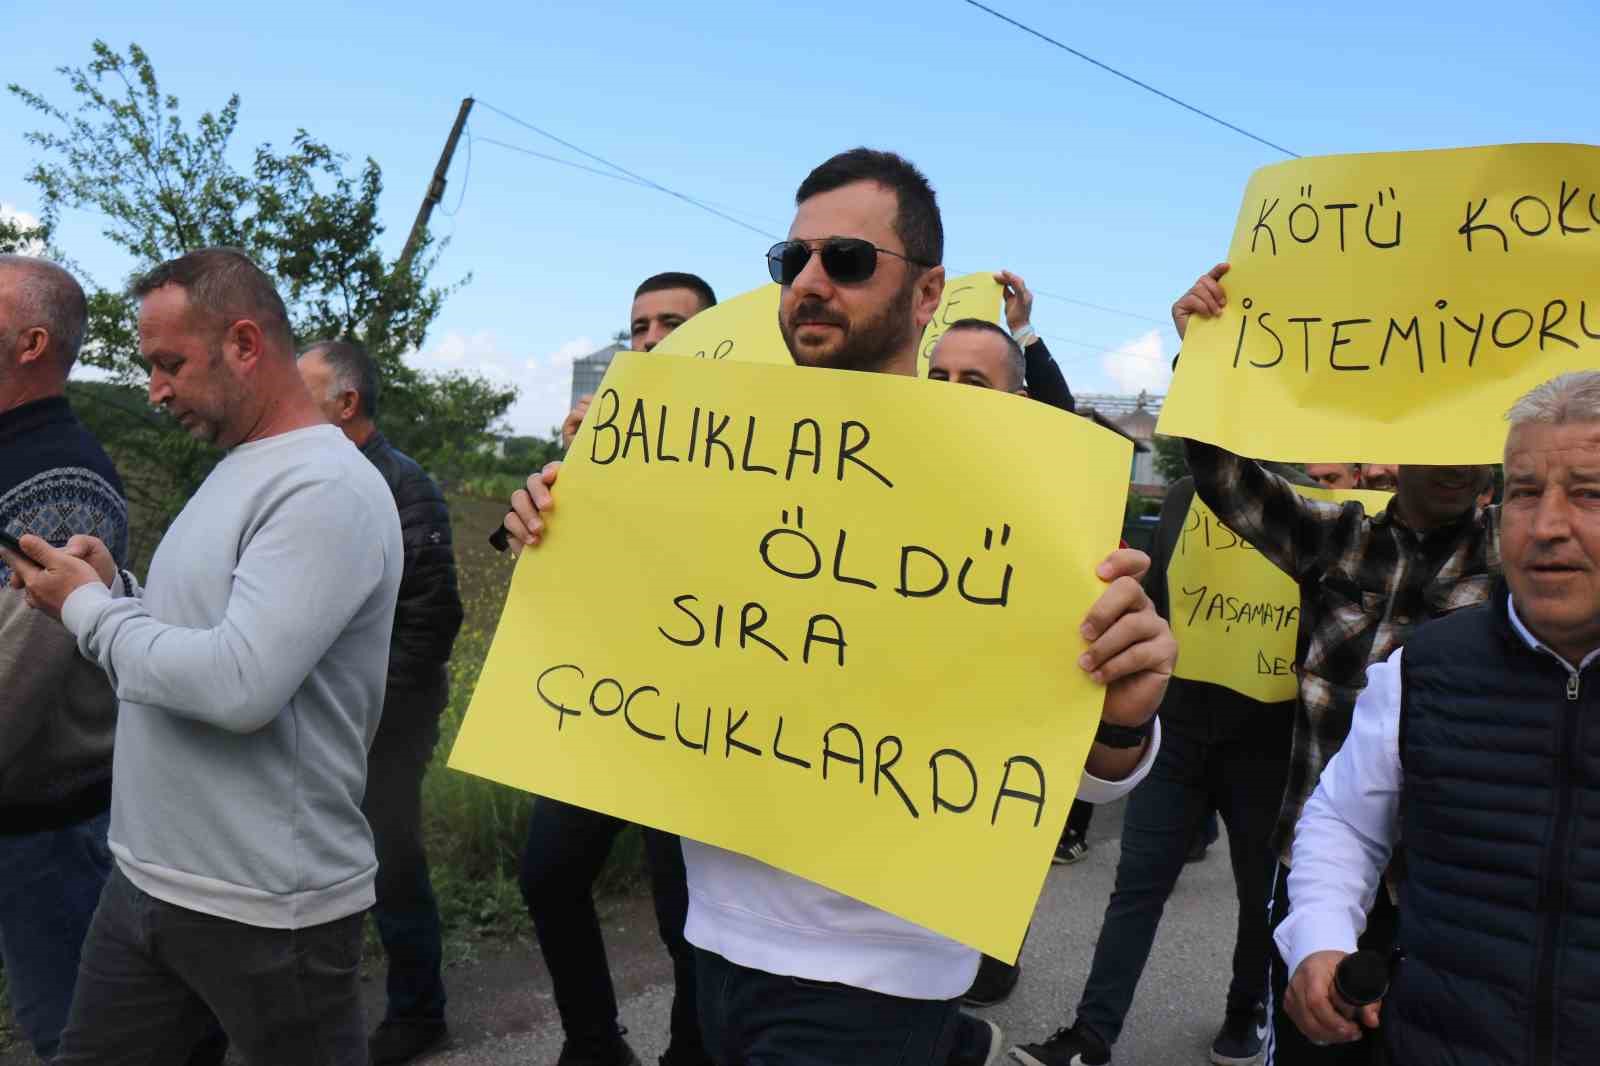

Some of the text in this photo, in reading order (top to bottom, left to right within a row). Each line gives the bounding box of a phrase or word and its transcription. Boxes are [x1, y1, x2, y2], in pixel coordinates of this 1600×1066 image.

[1251, 183, 1402, 256] KÖTÜ
[590, 388, 894, 489] BALIKLAR
[759, 505, 1014, 608] ÖLDÜ
[658, 594, 848, 667] SIRA
[536, 664, 1046, 827] ÇOCUKLARDA
